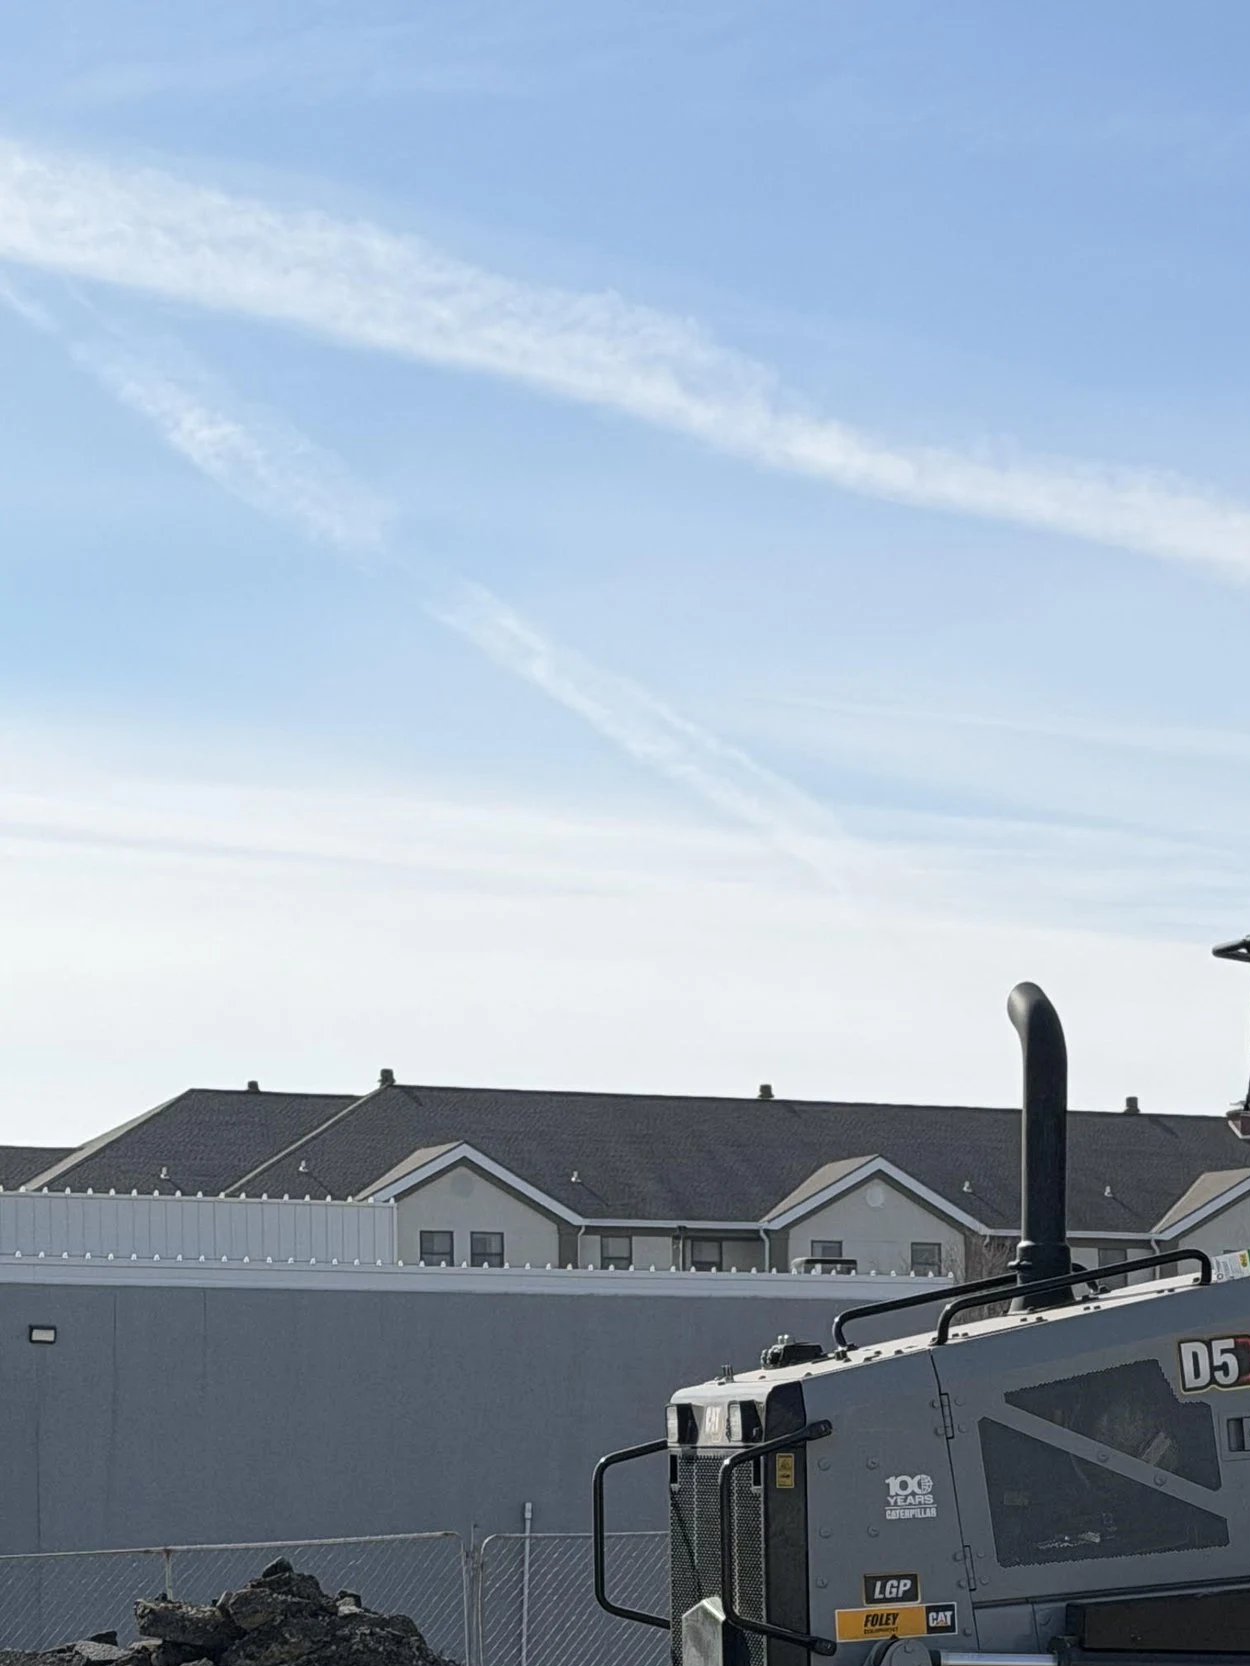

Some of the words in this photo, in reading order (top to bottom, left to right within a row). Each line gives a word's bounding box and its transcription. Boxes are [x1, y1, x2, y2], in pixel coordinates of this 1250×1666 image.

[1180, 1338, 1239, 1389] D5
[885, 1474, 933, 1496] 100
[887, 1494, 934, 1505] YEARS
[886, 1507, 937, 1519] CATERPILLAR
[874, 1579, 912, 1599] LGP
[864, 1612, 899, 1628] FOLEY
[929, 1611, 953, 1627] CAT
